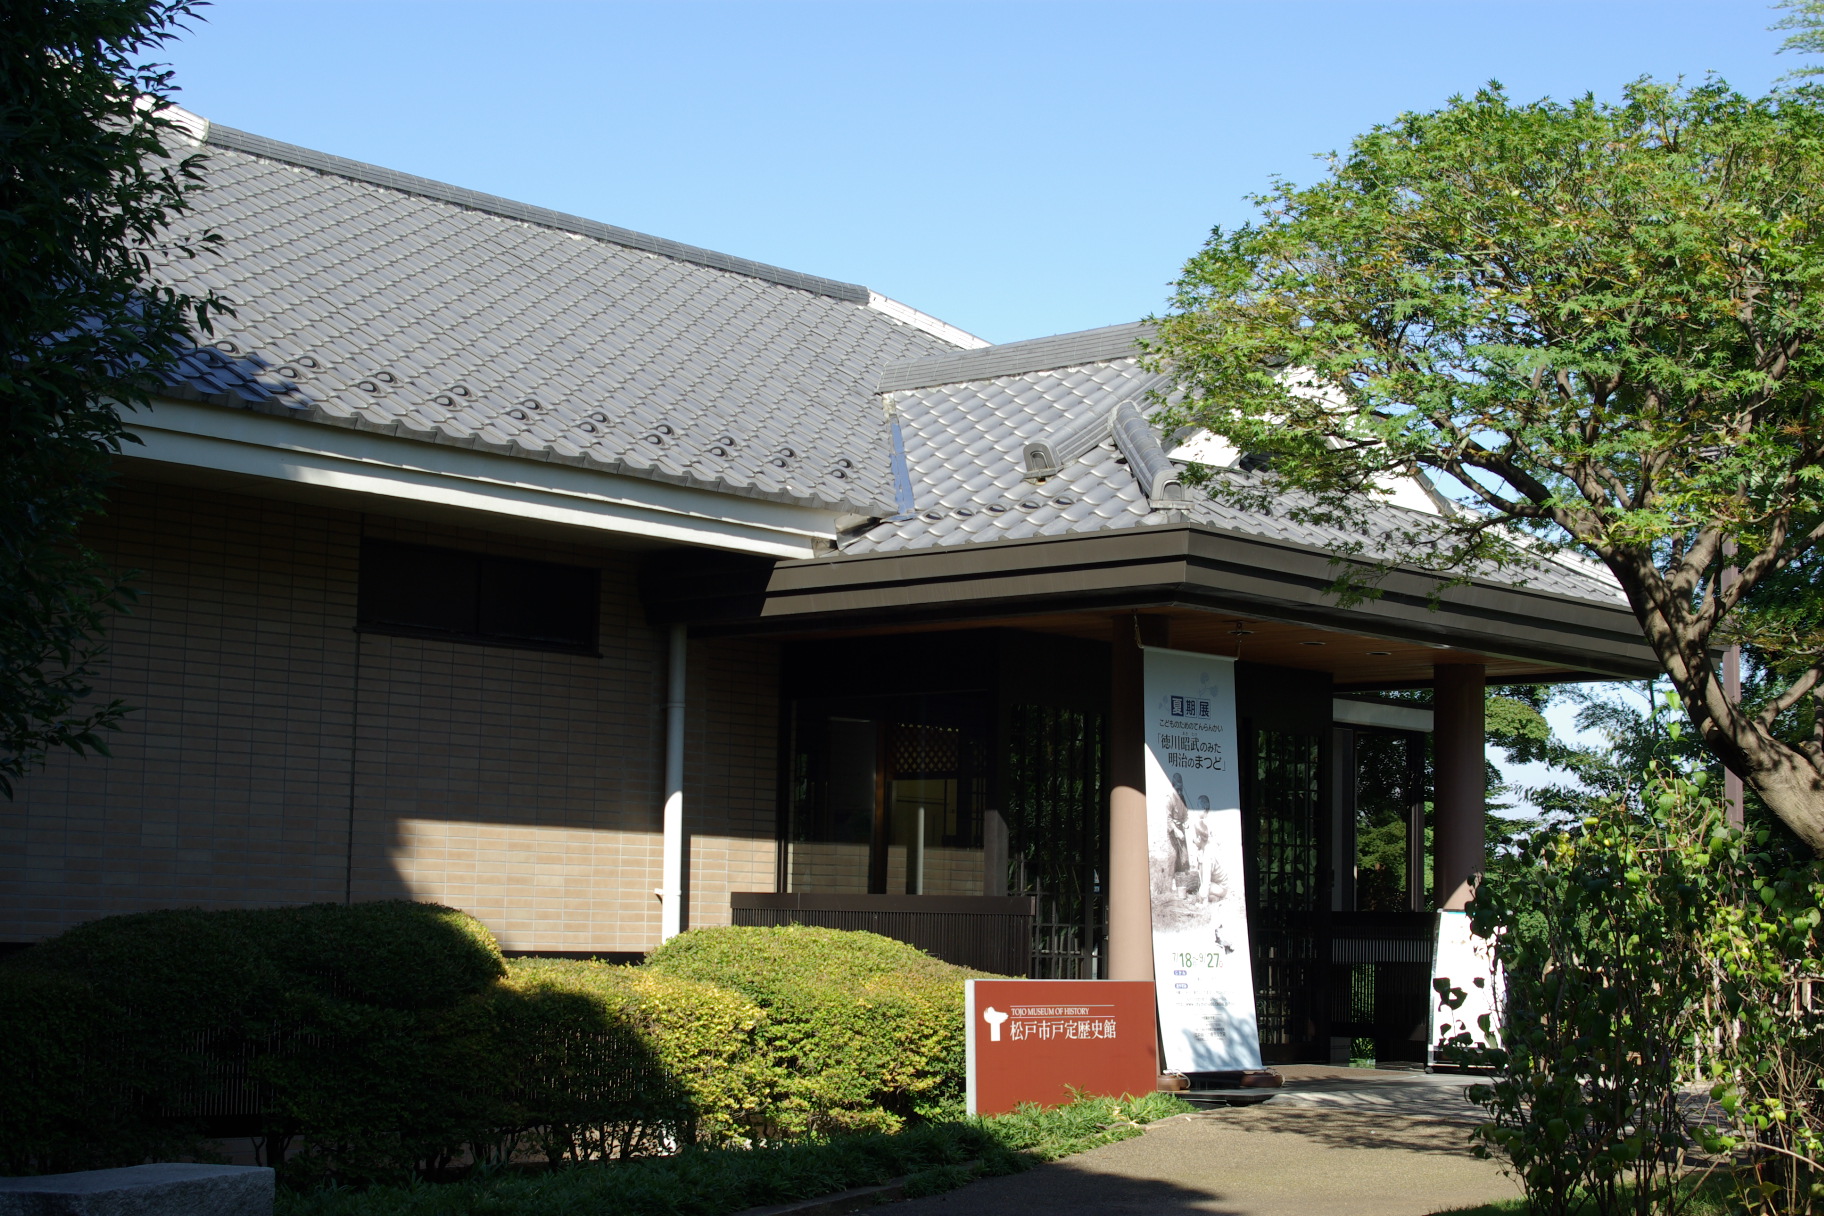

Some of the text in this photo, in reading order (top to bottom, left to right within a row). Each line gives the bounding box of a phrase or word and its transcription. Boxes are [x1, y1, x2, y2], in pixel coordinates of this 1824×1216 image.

[1171, 696, 1210, 719] 夏期展
[1160, 719, 1223, 732] こどものためのてんらんかい
[1011, 1008, 1026, 1016] TOJO
[1027, 1008, 1053, 1016] MUSEUM
[1064, 1007, 1089, 1015] HISTORY
[1010, 1019, 1116, 1041] 松戸市戸定歴史館
